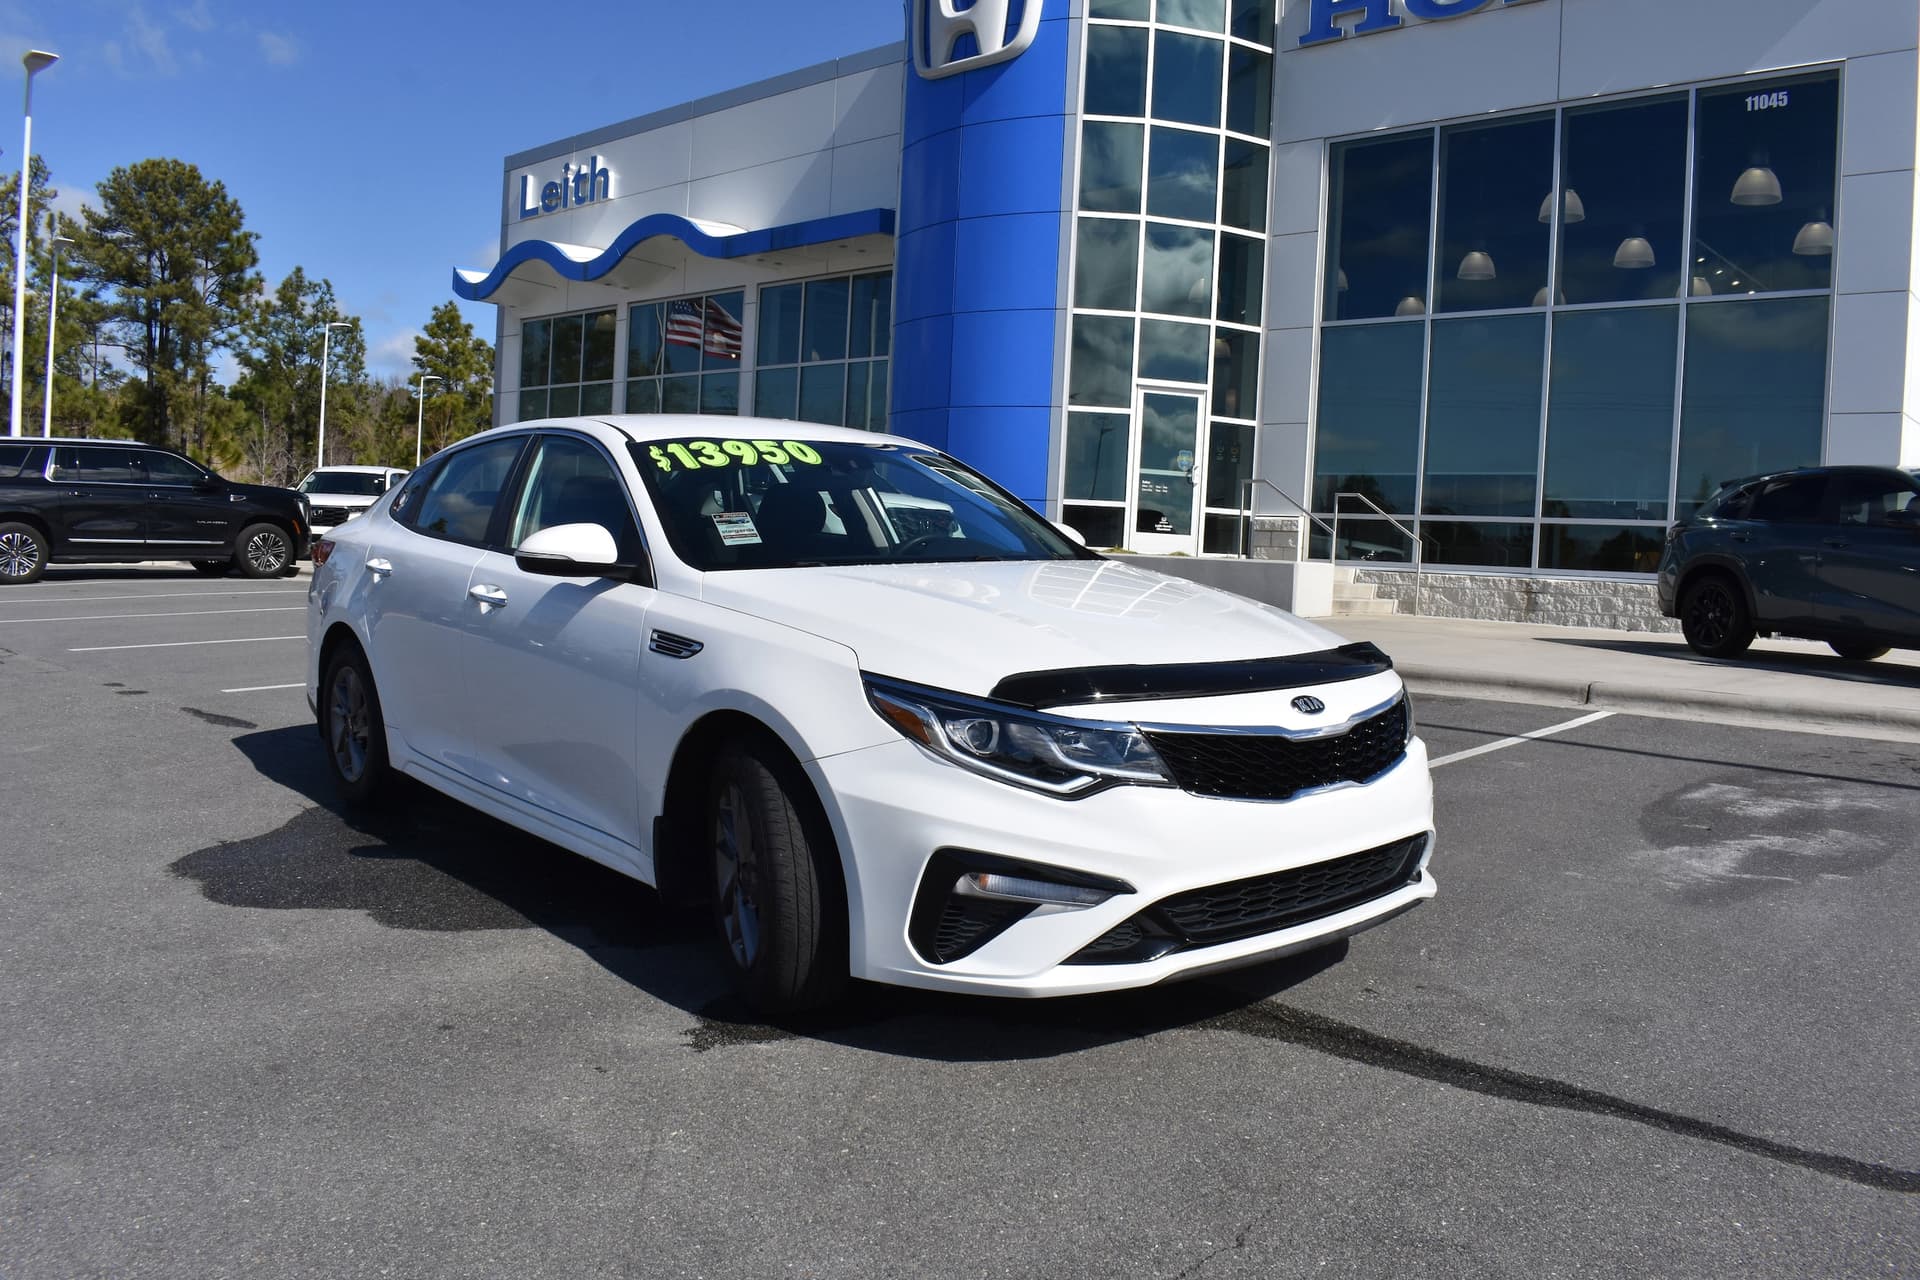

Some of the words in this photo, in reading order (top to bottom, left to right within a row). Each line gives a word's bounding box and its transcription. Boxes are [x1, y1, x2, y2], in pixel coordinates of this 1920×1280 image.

[1745, 91, 1788, 111] 11045
[520, 155, 612, 220] Leith
[649, 440, 822, 472] $13950
[1293, 696, 1324, 713] KIA
